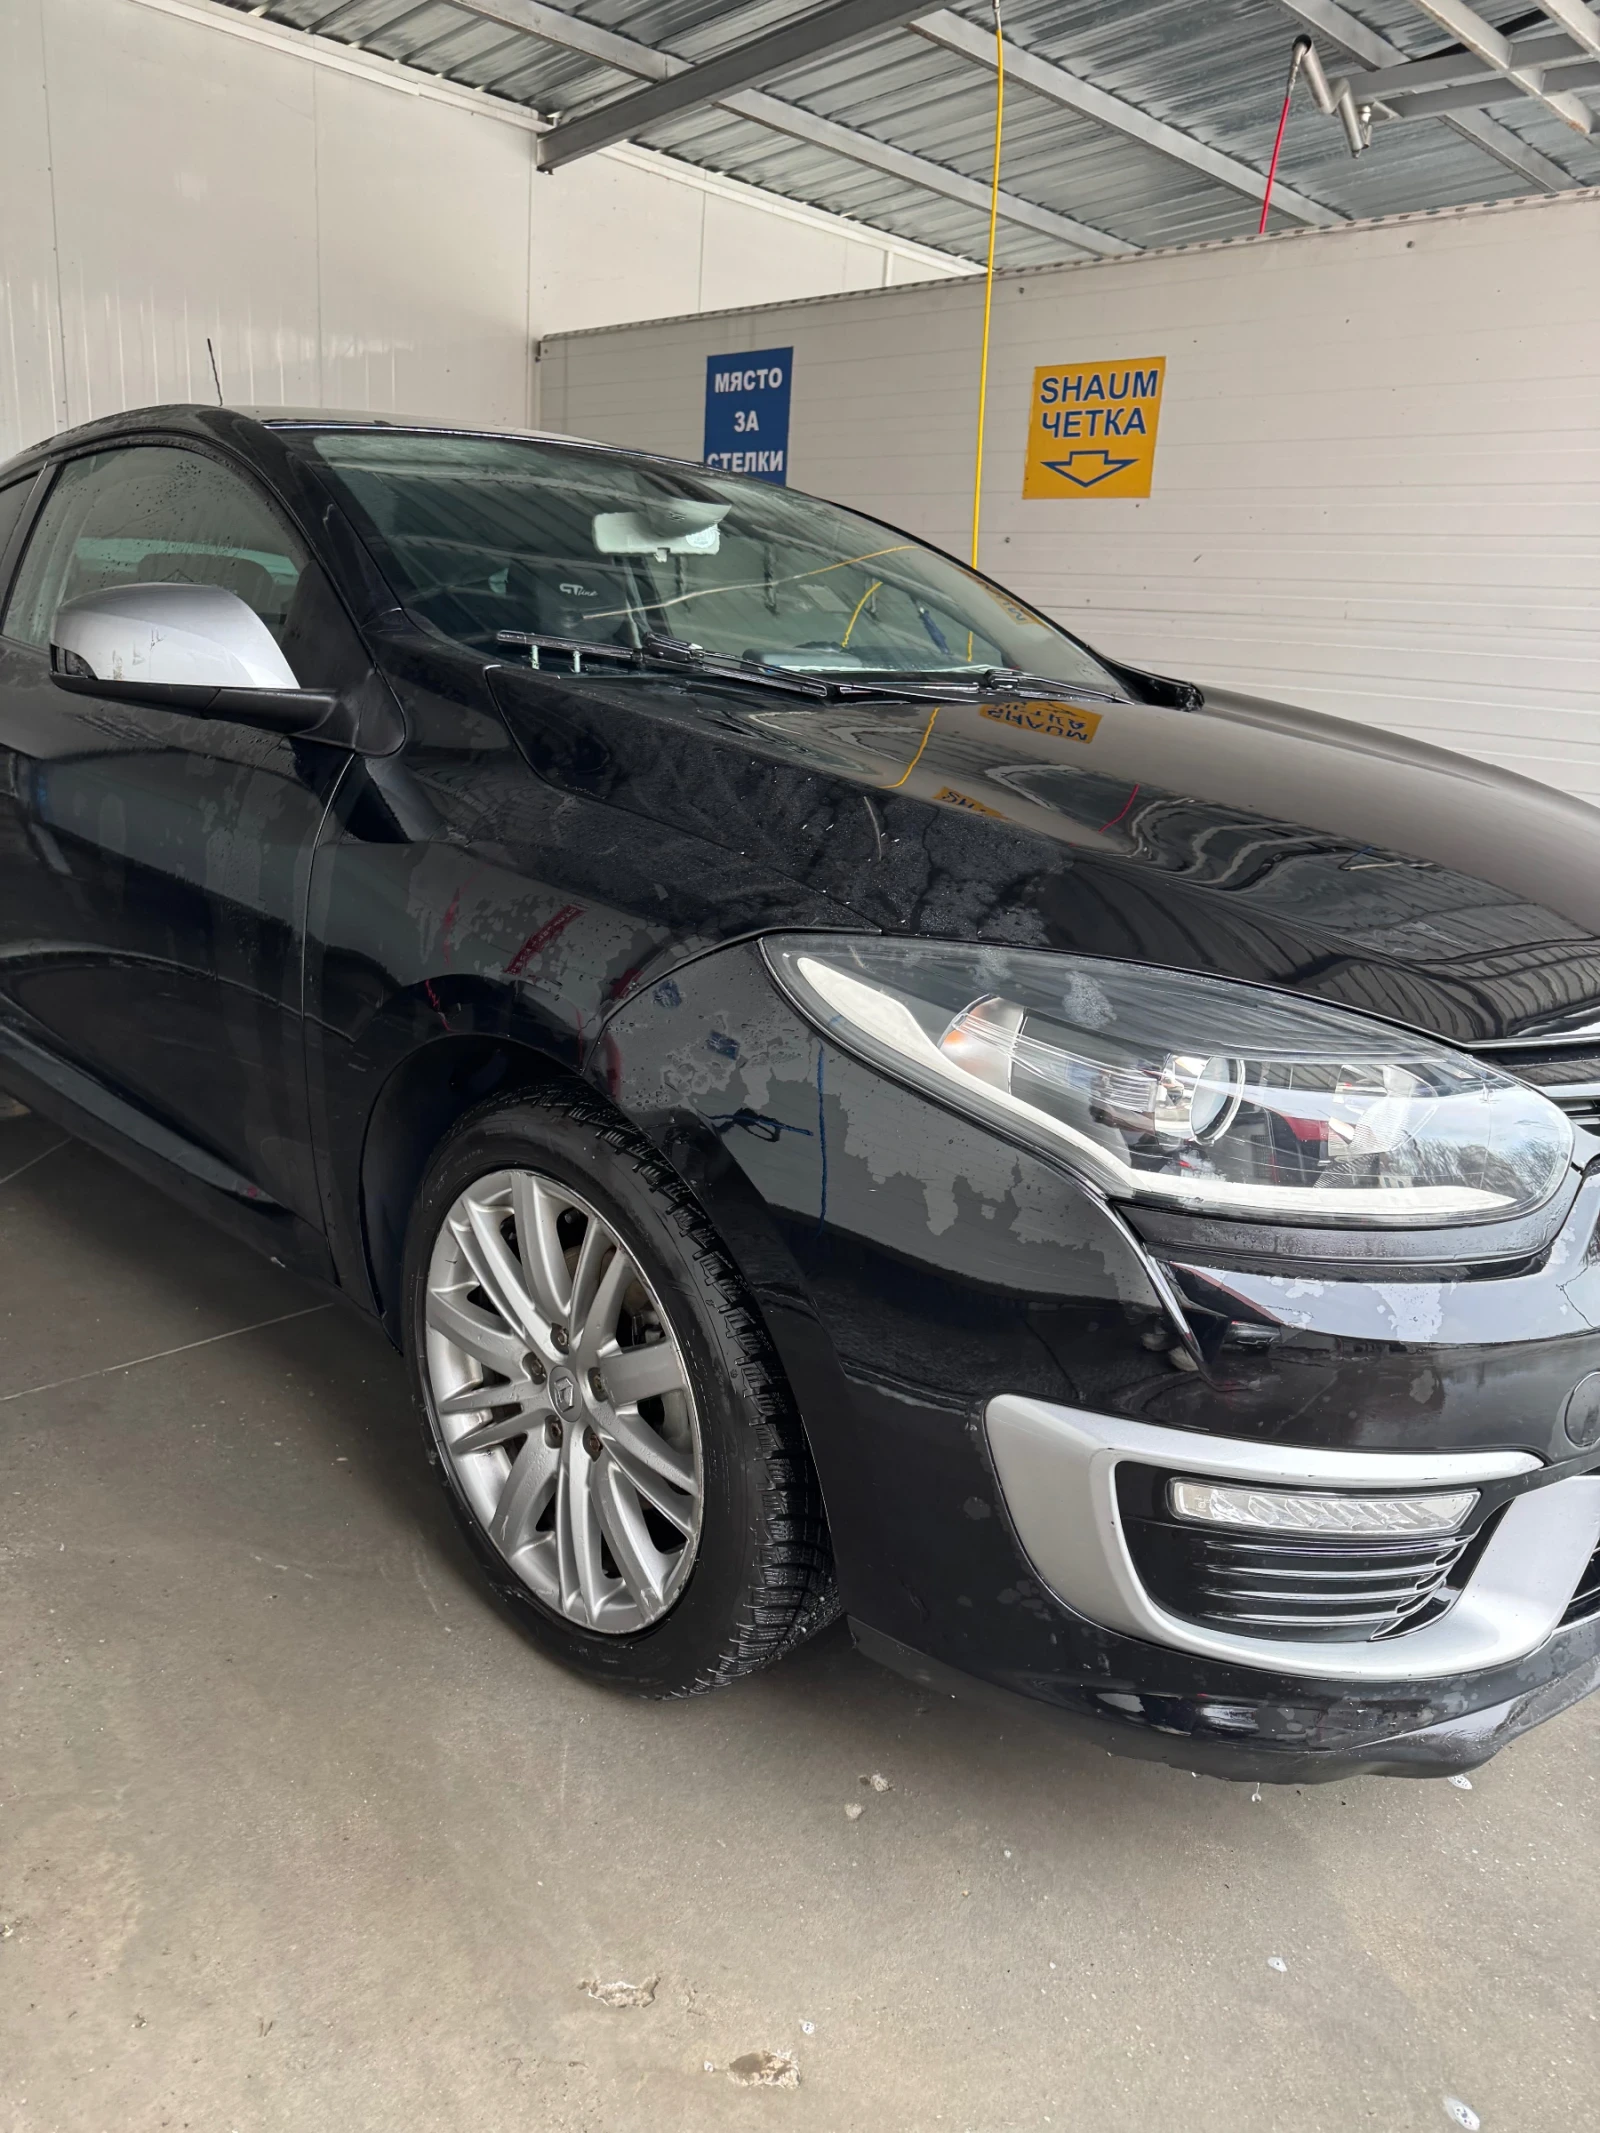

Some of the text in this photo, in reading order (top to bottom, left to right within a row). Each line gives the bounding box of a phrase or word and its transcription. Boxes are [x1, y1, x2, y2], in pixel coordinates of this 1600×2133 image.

[714, 367, 783, 393] МЯСТО
[1040, 369, 1159, 404] SHAUM
[733, 410, 759, 432] ЗА
[1042, 407, 1147, 438] ЧЕТКА
